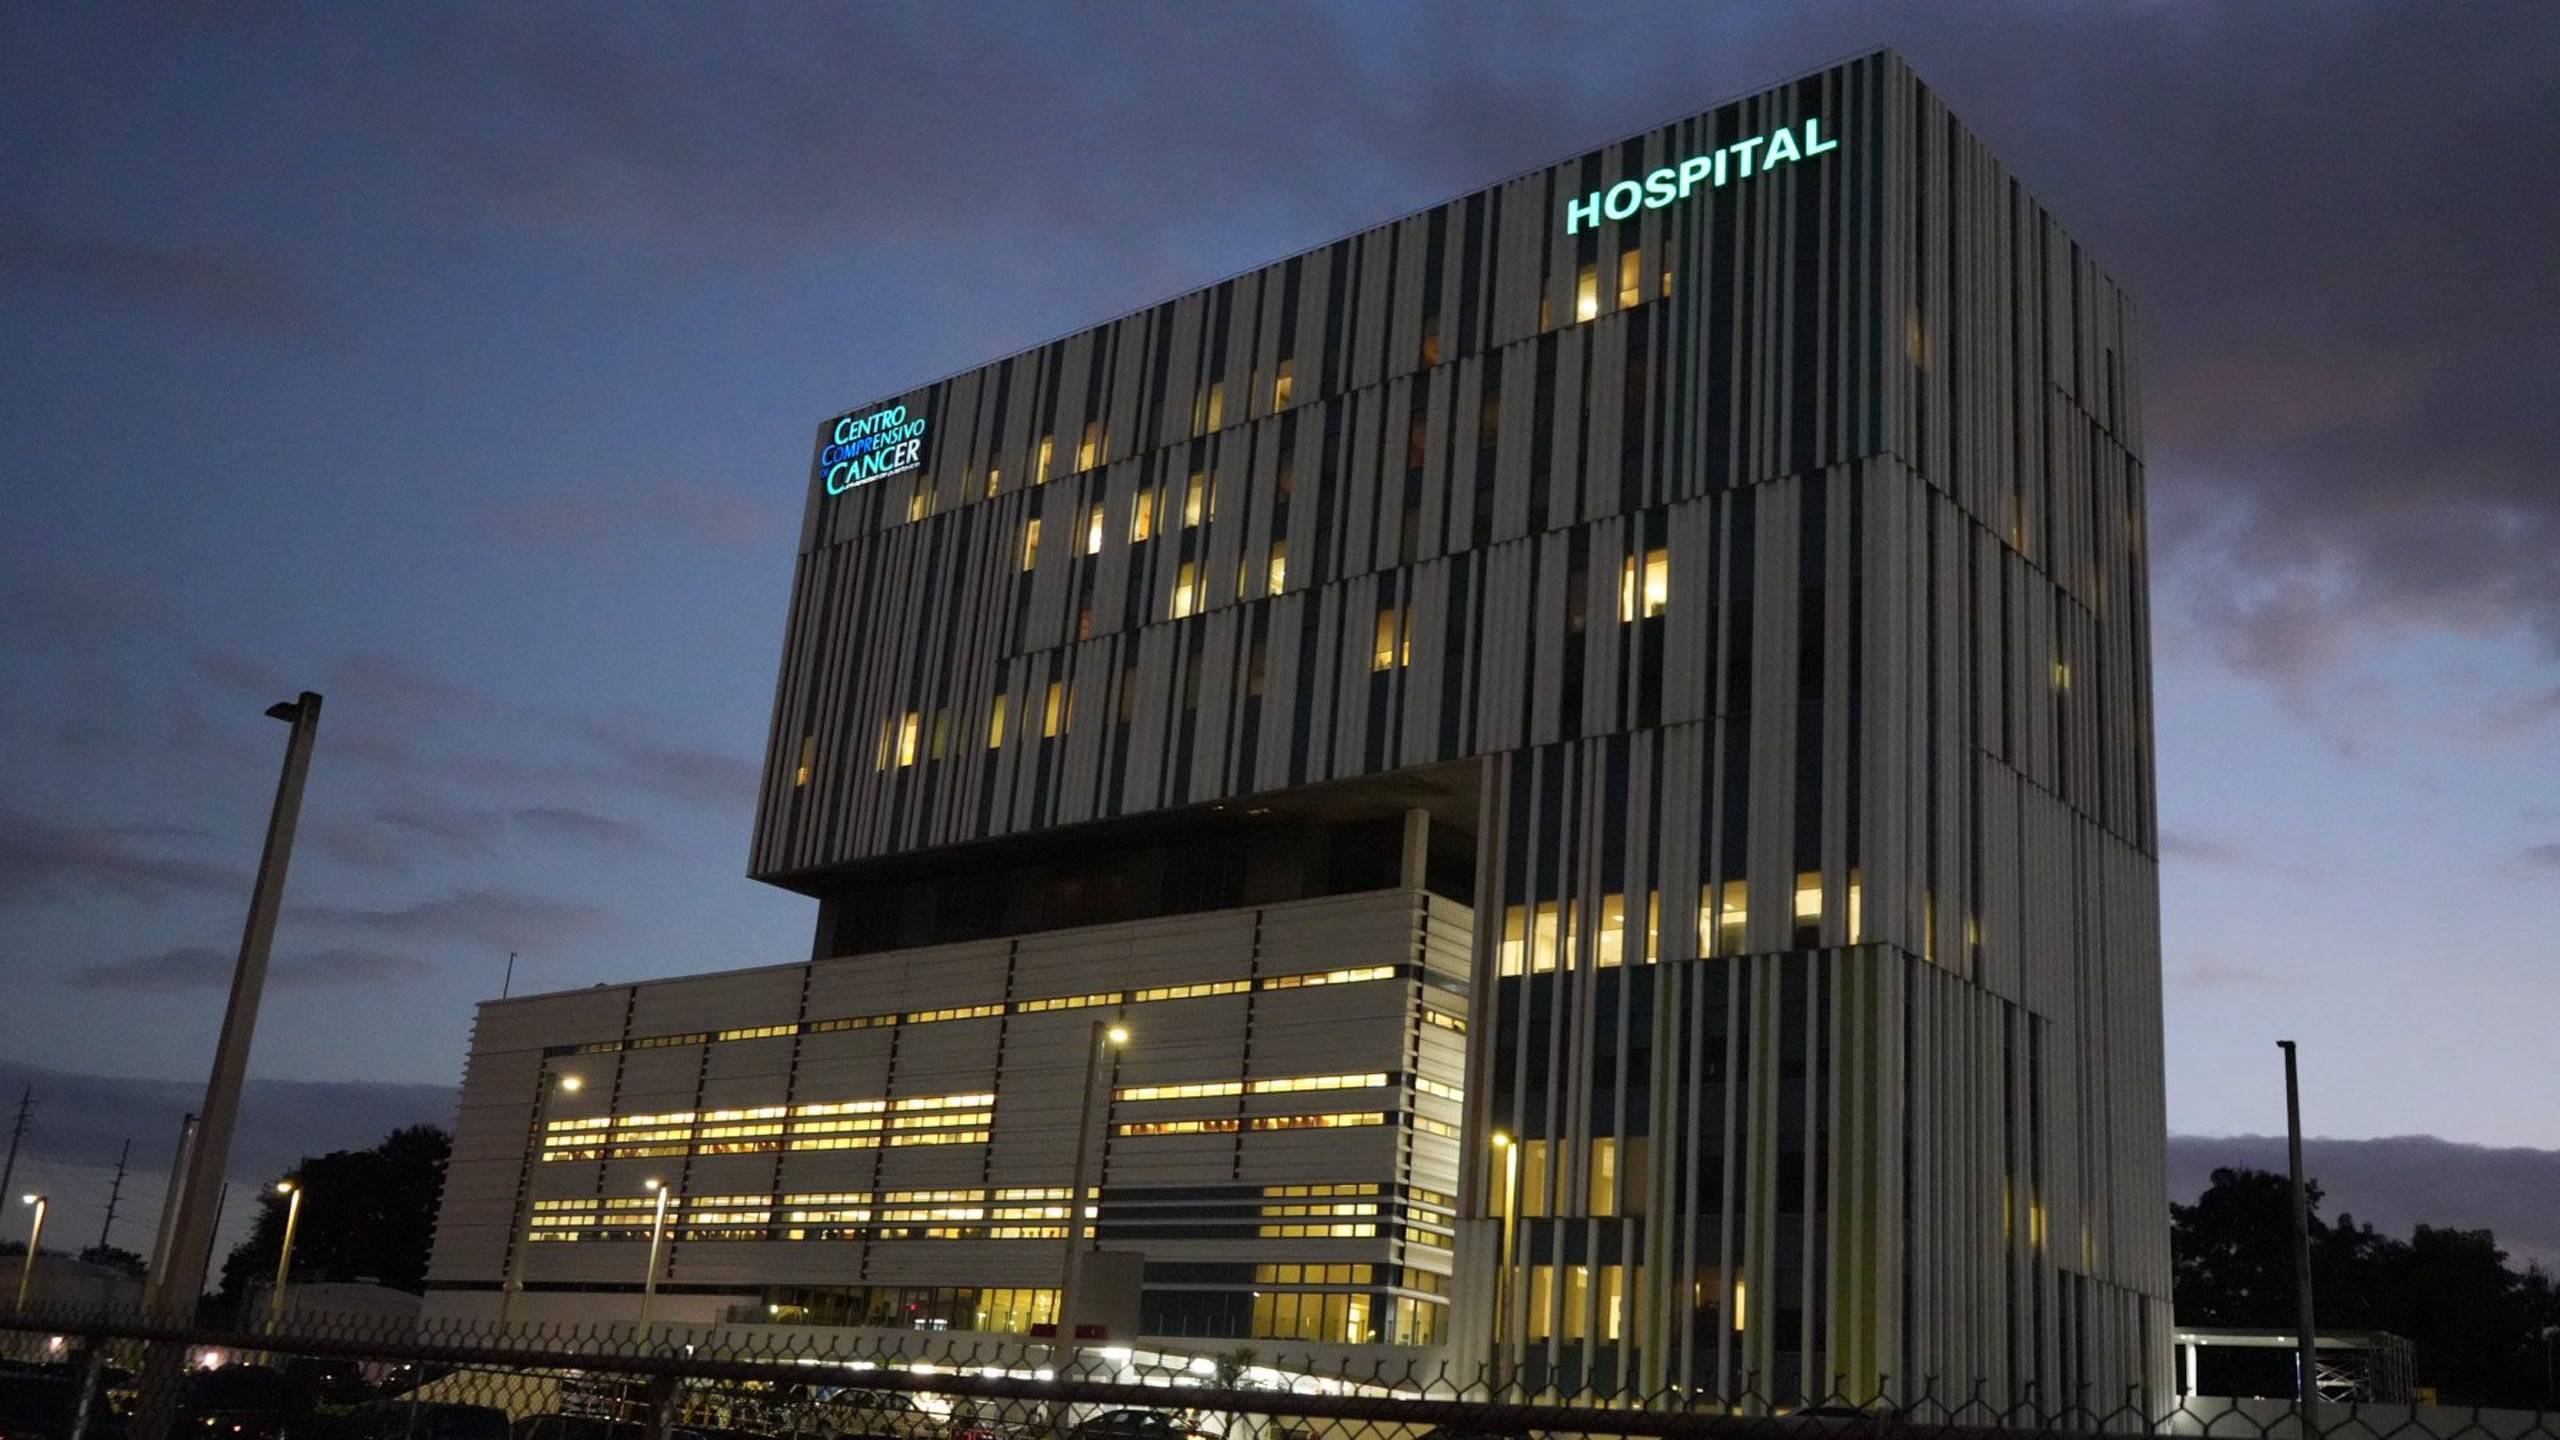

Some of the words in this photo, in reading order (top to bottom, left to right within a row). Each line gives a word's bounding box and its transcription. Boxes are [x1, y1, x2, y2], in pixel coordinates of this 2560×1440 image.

[1566, 118, 1837, 235] HOSPITAL
[822, 419, 925, 466] COMPRENSIVO
[834, 405, 906, 445] CENTRO
[827, 439, 921, 495] CANCER
